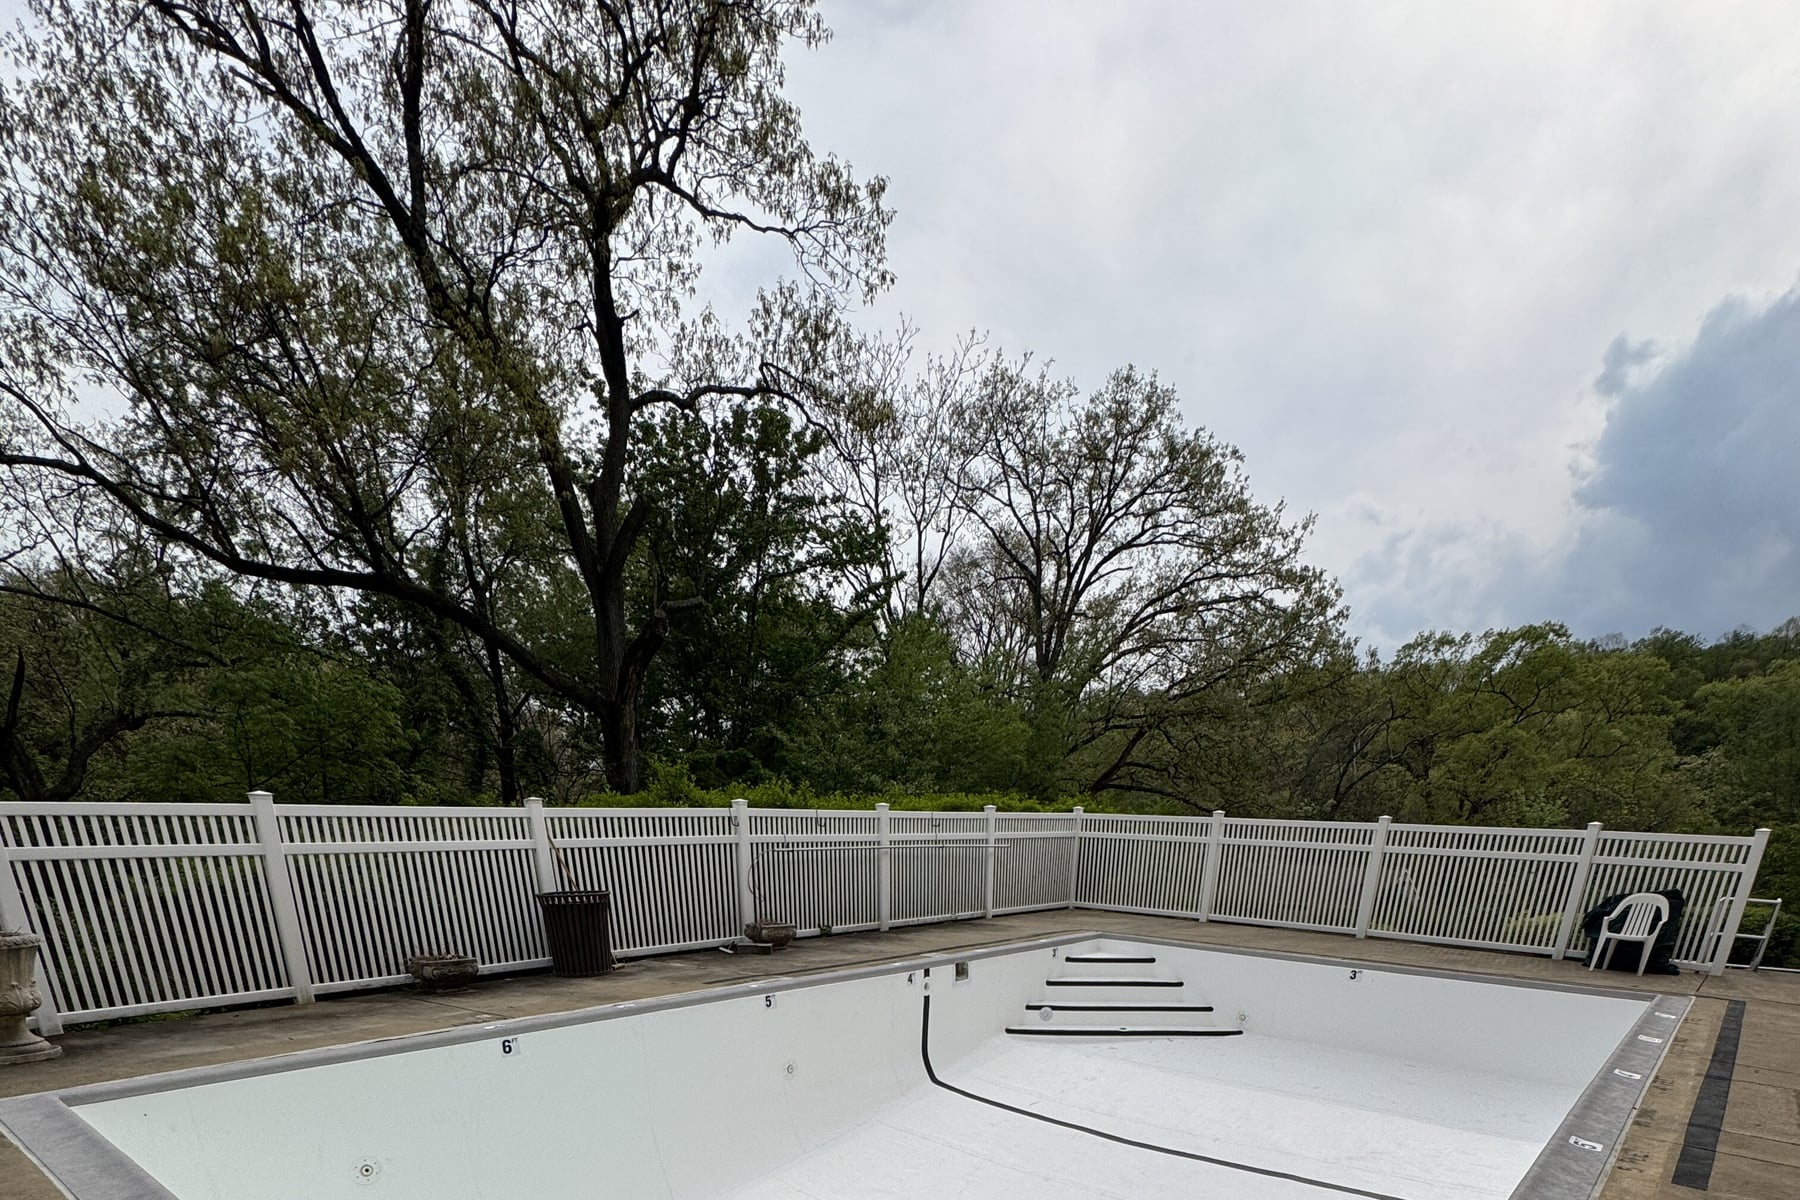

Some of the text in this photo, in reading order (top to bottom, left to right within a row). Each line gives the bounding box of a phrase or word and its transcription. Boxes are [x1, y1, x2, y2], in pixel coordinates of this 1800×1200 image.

[1350, 969, 1357, 980] 3
[765, 995, 772, 1008] 5
[502, 1039, 512, 1054] 6
